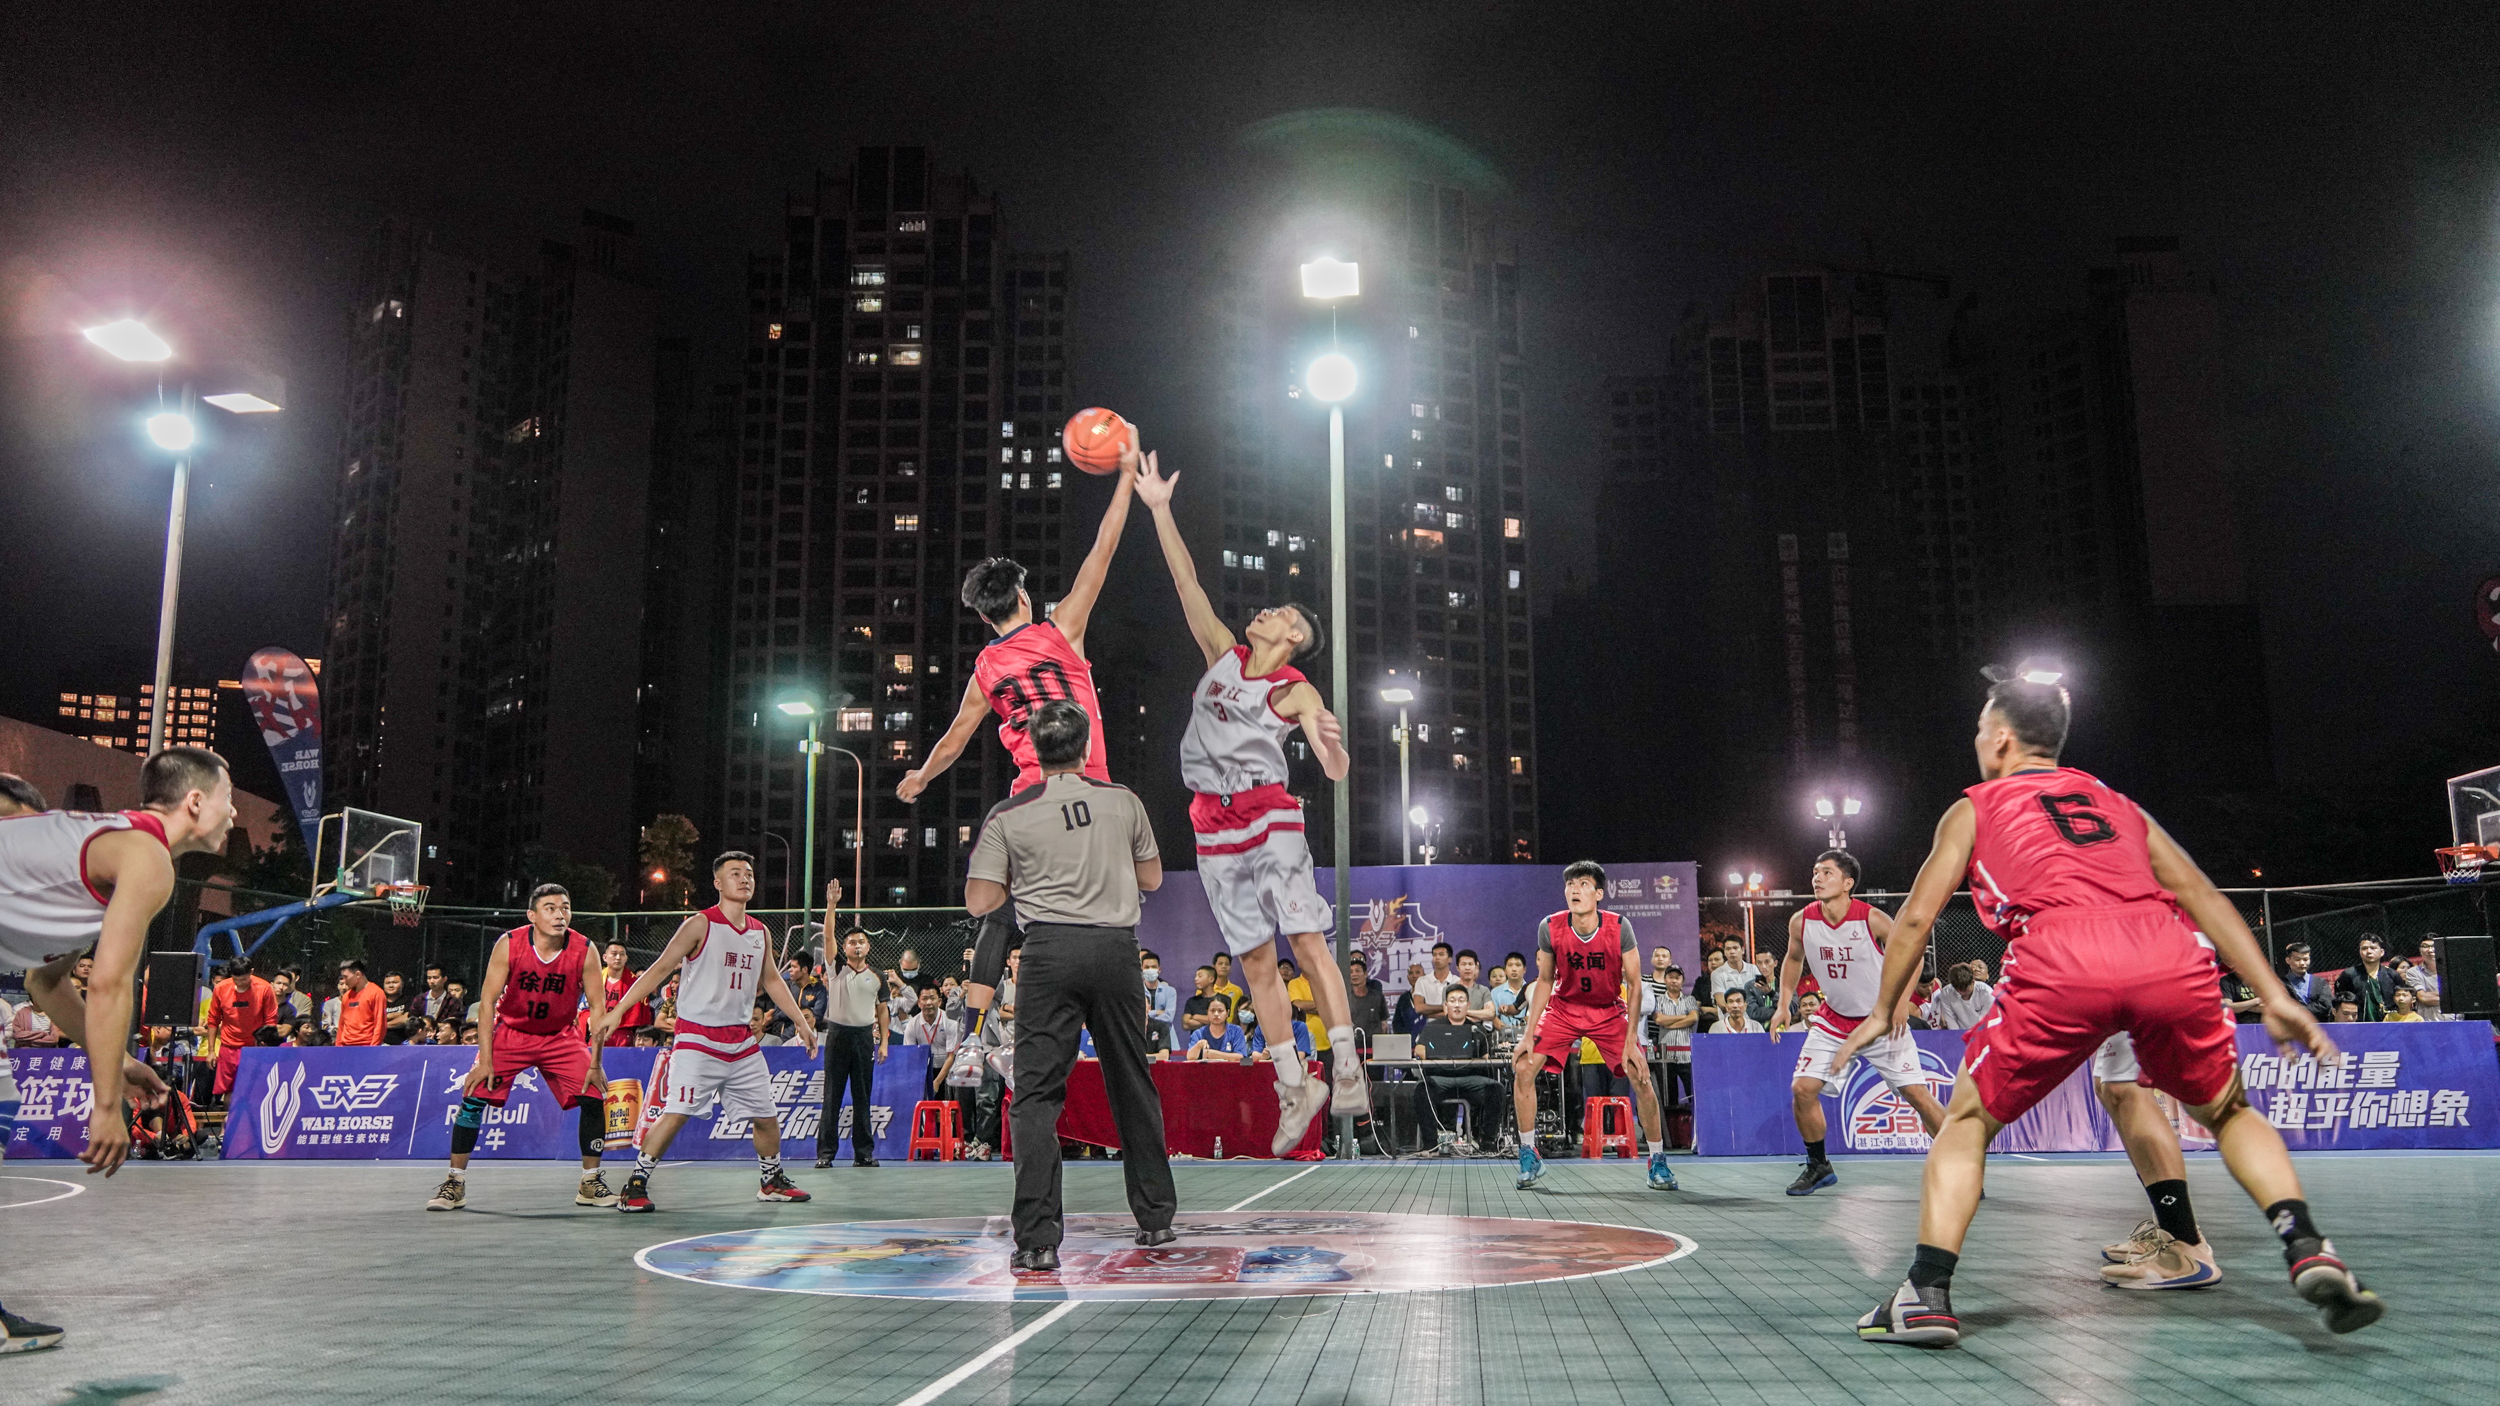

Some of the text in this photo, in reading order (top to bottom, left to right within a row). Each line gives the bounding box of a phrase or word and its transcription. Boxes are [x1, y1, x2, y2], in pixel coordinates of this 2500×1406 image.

[1213, 701, 1229, 722] 3
[1061, 800, 1092, 831] 10
[2034, 790, 2121, 849] 6
[724, 952, 754, 970] 廉江
[1565, 951, 1606, 971] 徐闻
[1820, 946, 1854, 961] 廉江
[1827, 963, 1848, 979] 67
[518, 971, 567, 995] 徐闻
[730, 972, 743, 990] 11
[1580, 977, 1592, 993] 9
[527, 1001, 549, 1019] 18
[2241, 1051, 2400, 1090] 你的能量
[679, 1086, 695, 1104] 11
[445, 1103, 529, 1126] RBull
[2268, 1089, 2471, 1130] 超乎你想象
[301, 1116, 394, 1131] WAR HORSE
[609, 1117, 630, 1128] 红牛
[1855, 1115, 1927, 1134] ZJB
[296, 1133, 390, 1145] 能量型维生素饮料
